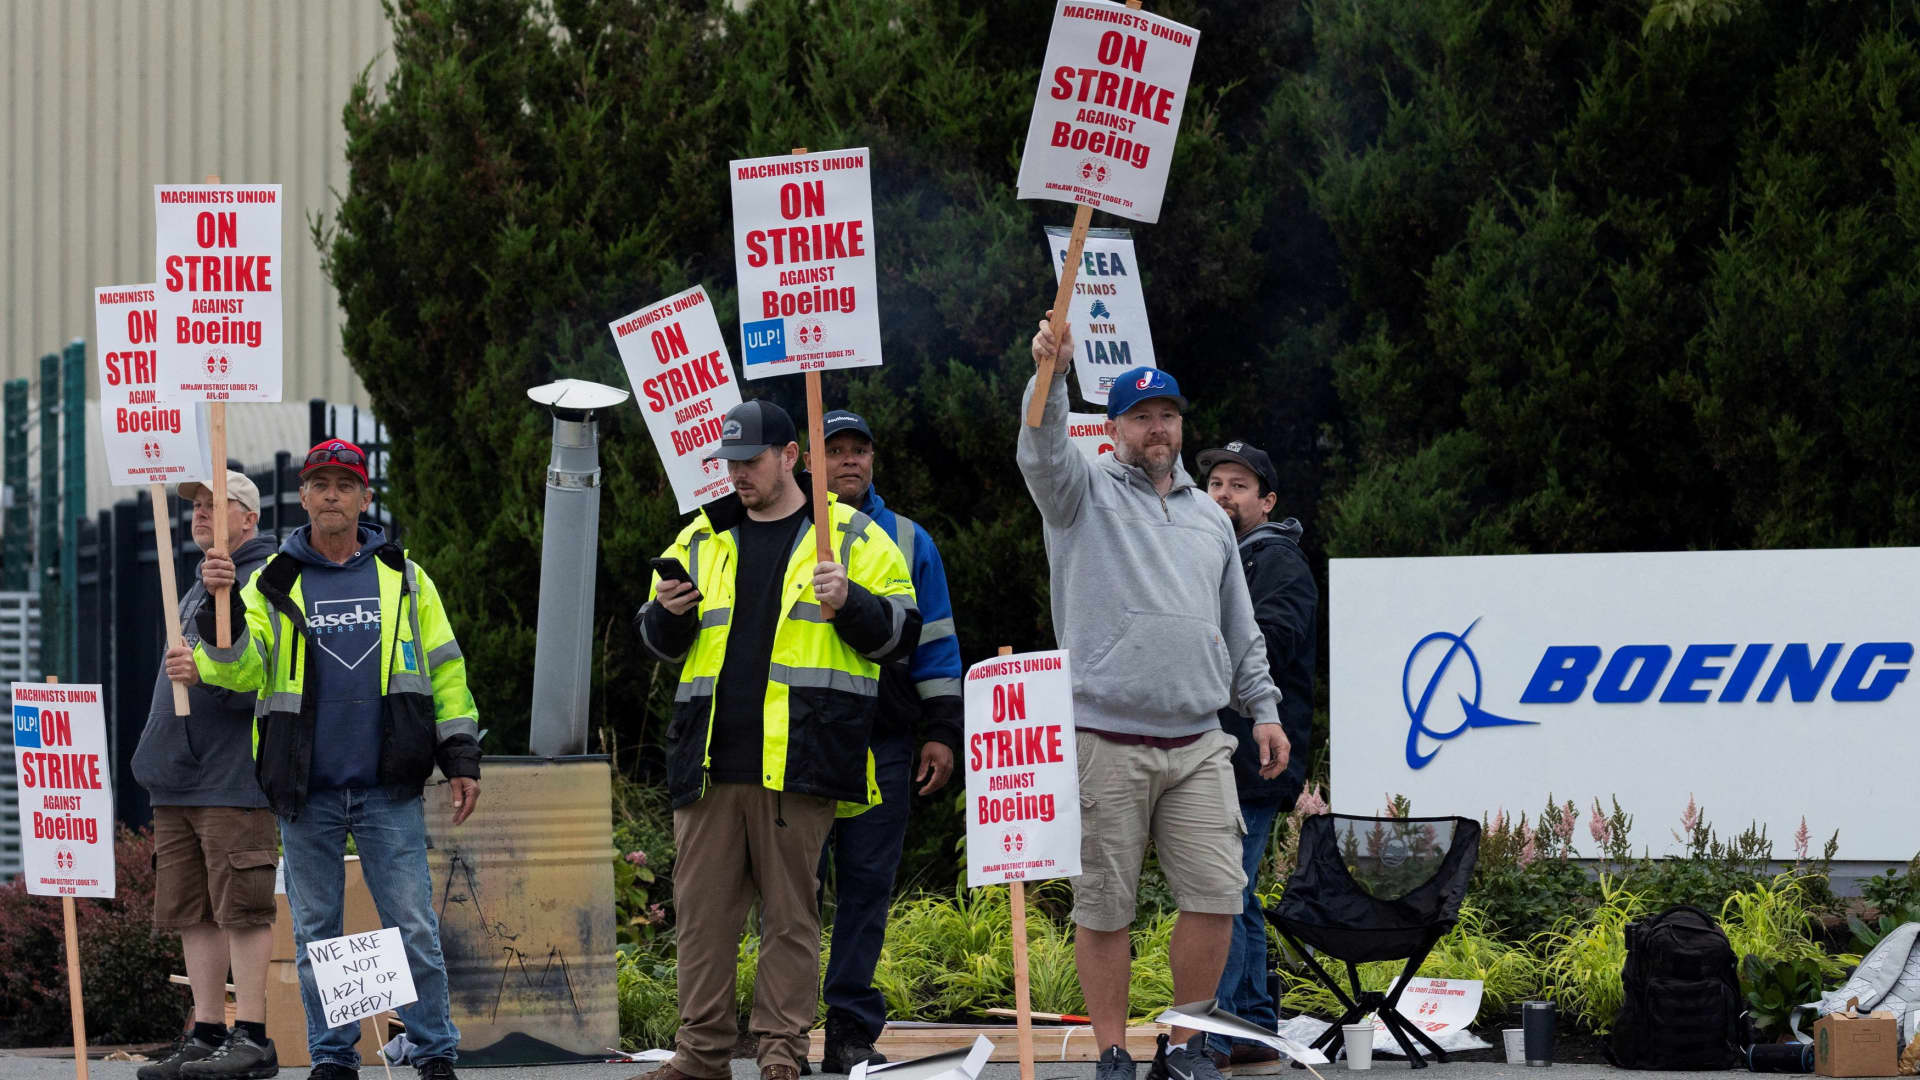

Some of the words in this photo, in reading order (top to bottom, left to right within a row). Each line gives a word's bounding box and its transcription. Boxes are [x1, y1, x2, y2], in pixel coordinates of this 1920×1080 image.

[1063, 6, 1148, 31] MACHINISTS
[1151, 23, 1192, 47] UNION
[1098, 30, 1147, 73] ON
[1051, 66, 1175, 125] STRIKE
[1076, 108, 1136, 134] AGAINST
[1051, 121, 1150, 170] Boeing
[738, 160, 819, 180] MACHINISTS
[823, 156, 864, 171] UNION
[160, 192, 234, 204] MACHINISTS
[237, 191, 276, 203] UNION
[780, 180, 825, 220] ON
[1074, 186, 1101, 198] DISTRICT
[1102, 194, 1122, 204] LODGE
[1123, 200, 1132, 208] 751
[1075, 194, 1100, 206] AFL-CIO
[196, 212, 237, 248] ON
[746, 220, 865, 268] STRIKE
[166, 256, 272, 292] STRIKE
[780, 266, 835, 286] AGAINST
[100, 291, 154, 304] MACHINISTS
[762, 286, 856, 318] Boeing
[1076, 283, 1117, 295] STANDS
[192, 299, 244, 314] AGAINST
[616, 305, 673, 337] MACHINISTS
[674, 291, 705, 313] UNION
[128, 310, 156, 344] ON
[176, 316, 262, 348] Boeing
[748, 330, 781, 349] ULP!
[1090, 324, 1116, 334] WITH
[650, 322, 689, 365] ON
[1085, 340, 1132, 364] IAM
[106, 350, 156, 386] STRI
[796, 353, 824, 361] DISTRICT
[800, 361, 824, 370] AFL-CIO
[643, 350, 729, 413] STRIKE
[1098, 376, 1117, 384] SPE
[129, 390, 156, 404] AGAIN
[116, 406, 181, 434] Boeing
[675, 398, 712, 424] AGAINST
[1068, 424, 1108, 438] ACHIN
[305, 605, 381, 627] aseba
[308, 624, 354, 634] GERS
[968, 660, 1020, 680] MACHINISTS
[1024, 657, 1061, 673] UNION
[1519, 642, 1914, 704] BOEING
[16, 689, 66, 702] MACHINISTS
[68, 690, 96, 703] UNION
[992, 682, 1026, 723] ON
[17, 716, 38, 732] ULP!
[41, 710, 72, 746] ON
[970, 725, 1064, 772] STRIKE
[22, 752, 102, 790] STRIKE
[990, 772, 1035, 792] AGAINST
[44, 796, 81, 810] AGAINST
[978, 792, 1055, 824] Boeing
[34, 812, 98, 844] Boeing
[1002, 862, 1024, 870] DISTRICT
[1026, 860, 1042, 868] LODGE
[1004, 871, 1024, 880] AFL-CIO
[310, 942, 344, 963] WE
[349, 933, 382, 954] ARE
[343, 955, 381, 974] NOT
[322, 977, 364, 1005] LAZY
[376, 972, 400, 984] OR
[330, 990, 392, 1024] GREEDY
